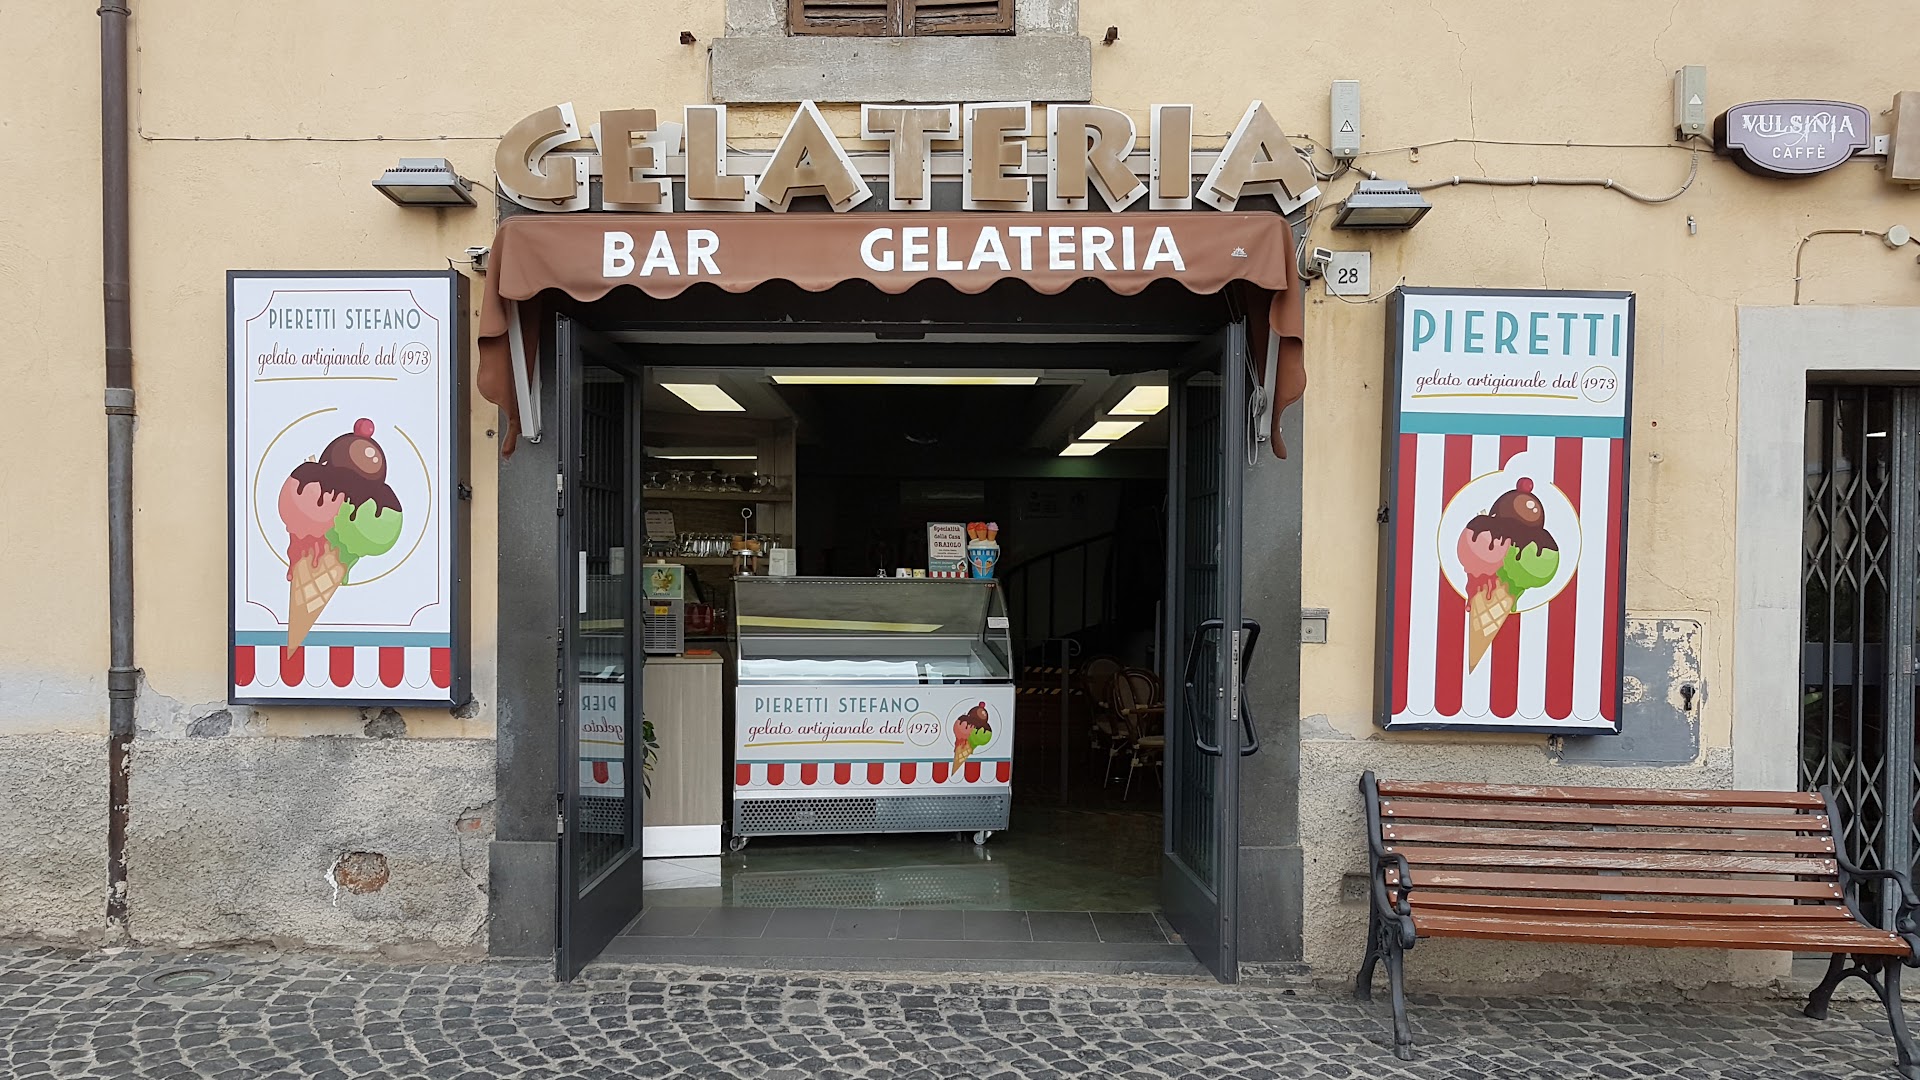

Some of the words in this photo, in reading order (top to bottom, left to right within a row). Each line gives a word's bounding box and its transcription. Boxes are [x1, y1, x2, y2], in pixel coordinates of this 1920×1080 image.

[1741, 111, 1856, 145] VULSINIA
[495, 101, 1320, 214] GELATERIA
[1772, 144, 1826, 159] CAFFÈ
[602, 229, 722, 278] BAR
[859, 225, 1187, 273] GELATERIA
[1338, 267, 1358, 284] 28
[269, 308, 336, 329] PIERETTI
[345, 308, 421, 330] STEFANO
[1411, 308, 1621, 357] PIERETTI
[258, 341, 298, 376] gelato
[301, 342, 371, 376] artigianale
[374, 342, 398, 366] dal
[401, 350, 429, 366] 1973
[1416, 368, 1463, 393] gelato
[1467, 370, 1548, 395] artigianale
[1552, 371, 1579, 389] dal
[1582, 377, 1616, 390] 1973
[755, 697, 828, 713] PIERETTI
[838, 697, 920, 713] STEFANO
[749, 717, 793, 742] gelato
[798, 716, 875, 742] artigianale
[879, 717, 905, 735] dal
[908, 722, 939, 735] 1973
